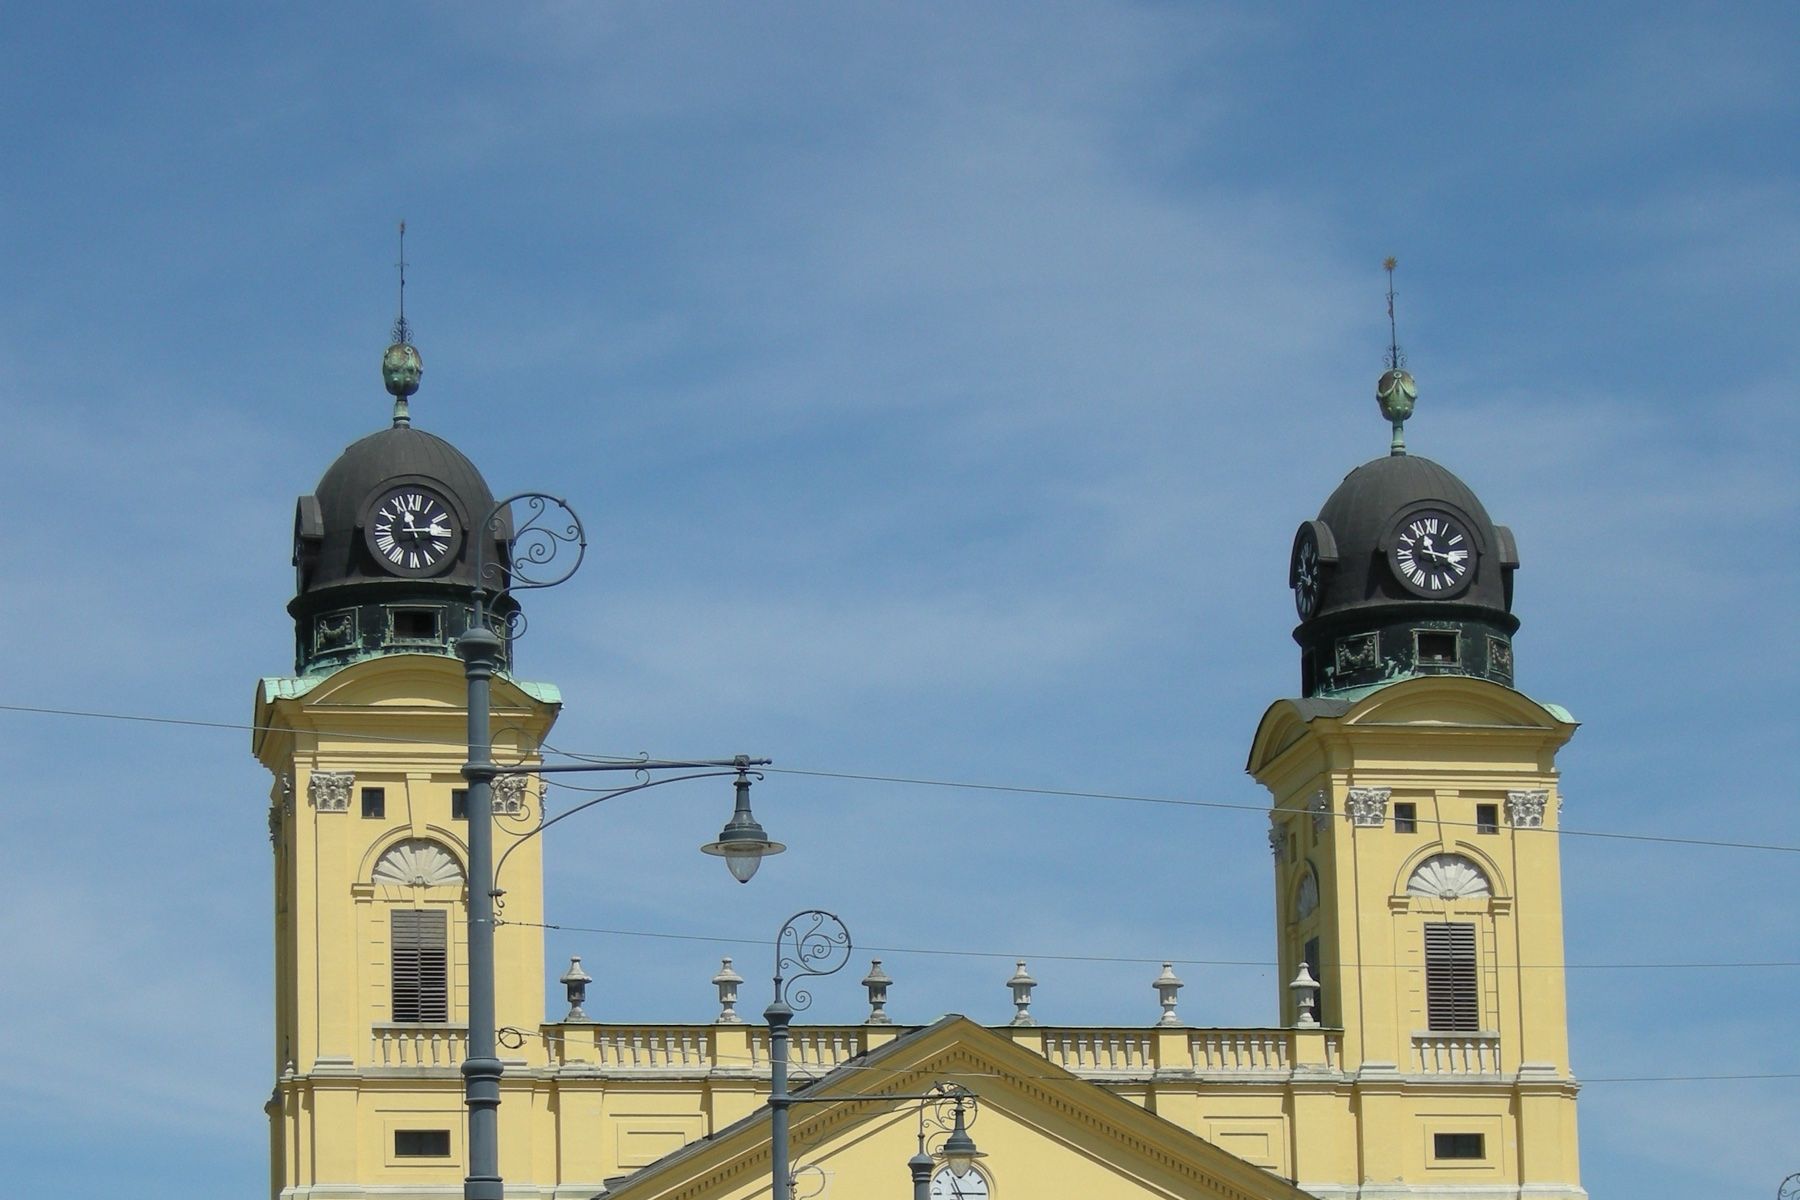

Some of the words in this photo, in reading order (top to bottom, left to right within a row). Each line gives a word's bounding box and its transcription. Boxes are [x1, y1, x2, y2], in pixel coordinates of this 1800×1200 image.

[407, 494, 423, 511] XII
[379, 507, 396, 522] X
[1424, 518, 1438, 535] XII
[1399, 533, 1416, 546] X
